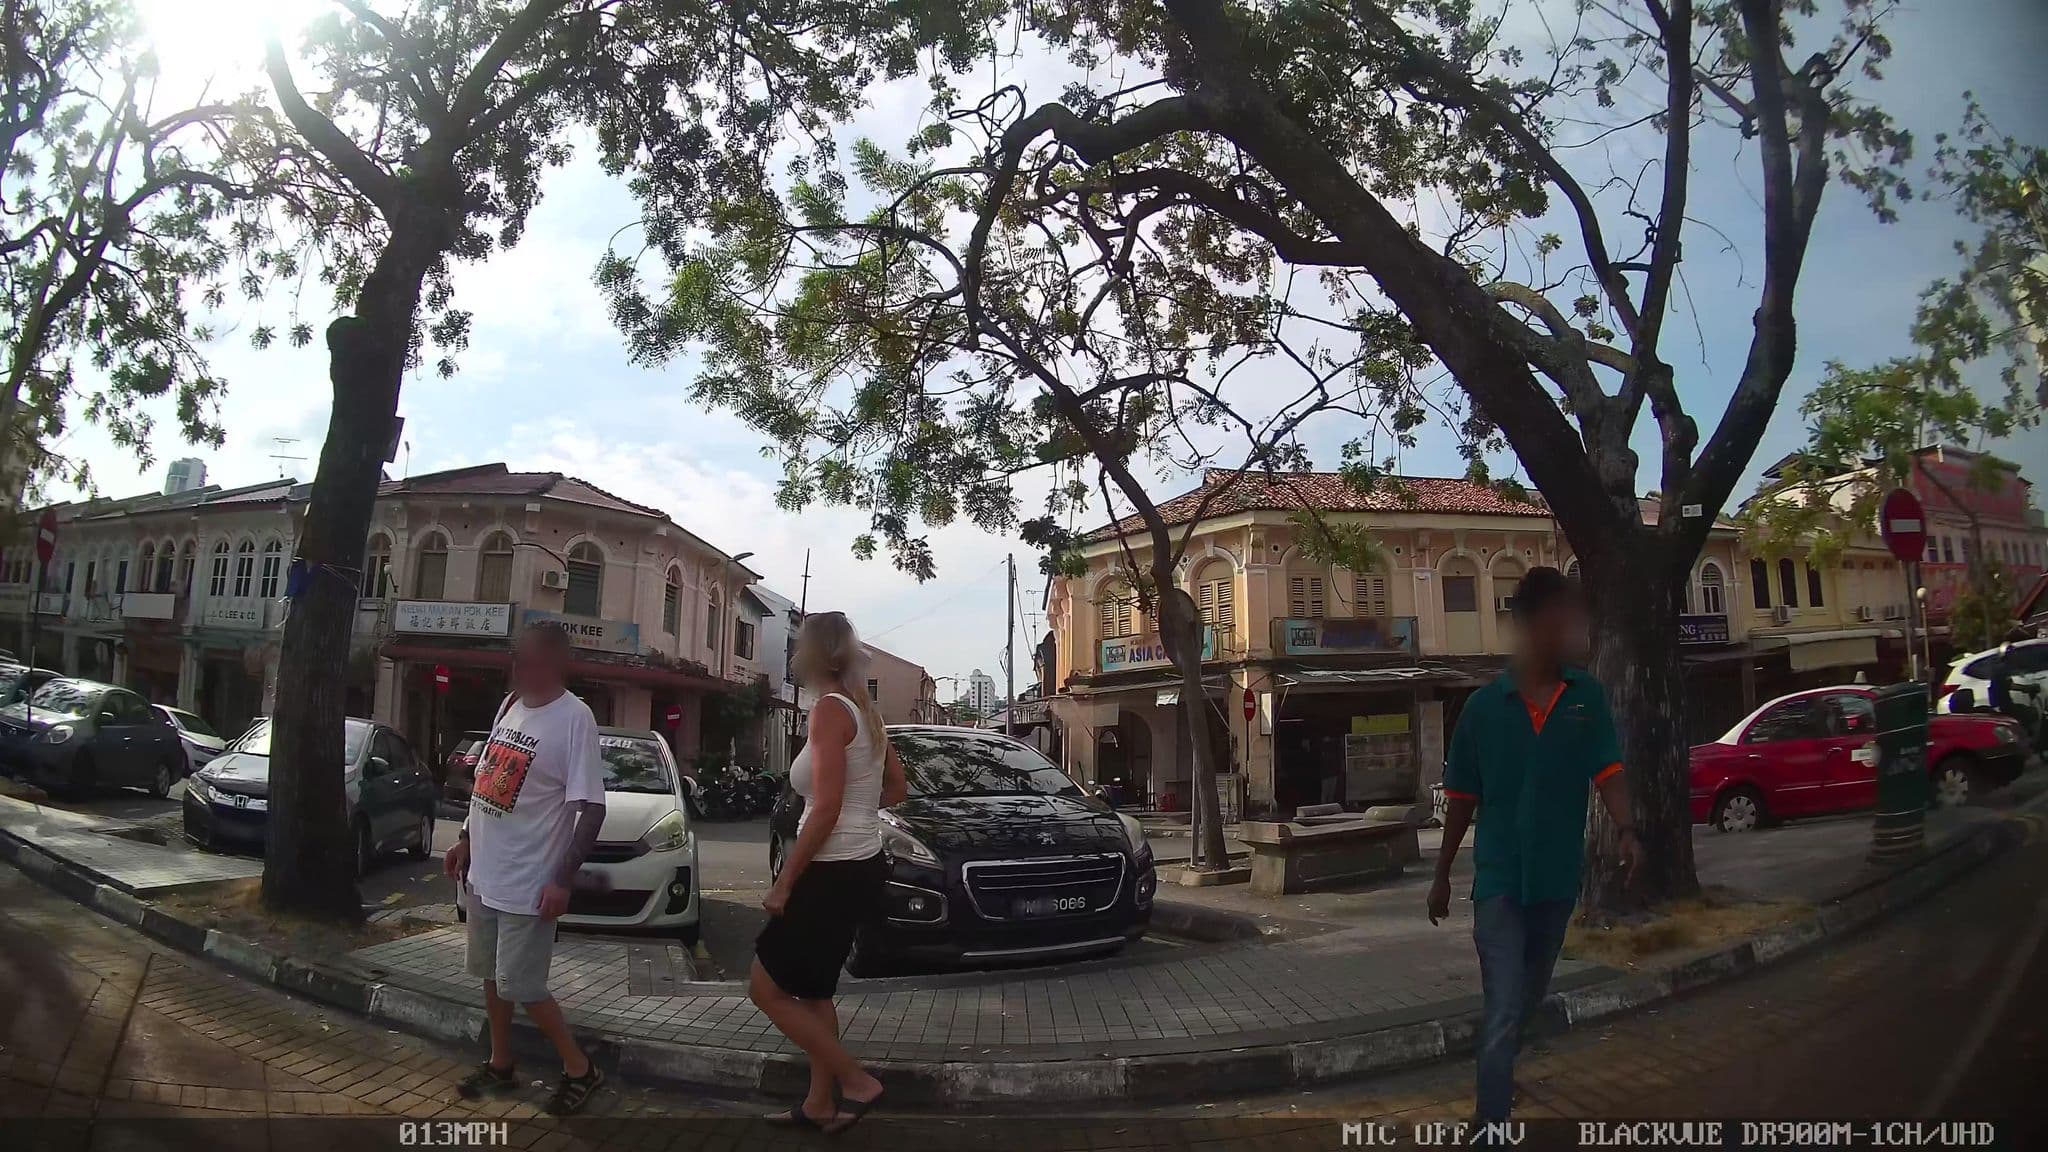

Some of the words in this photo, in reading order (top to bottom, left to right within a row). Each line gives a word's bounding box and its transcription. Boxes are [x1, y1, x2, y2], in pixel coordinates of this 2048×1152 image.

[225, 610, 239, 619] LEE
[464, 606, 481, 616] FOK
[485, 606, 505, 616] KEE
[580, 624, 604, 637] KEE
[1129, 645, 1154, 663] ASIA
[506, 728, 540, 750] PROBLEM
